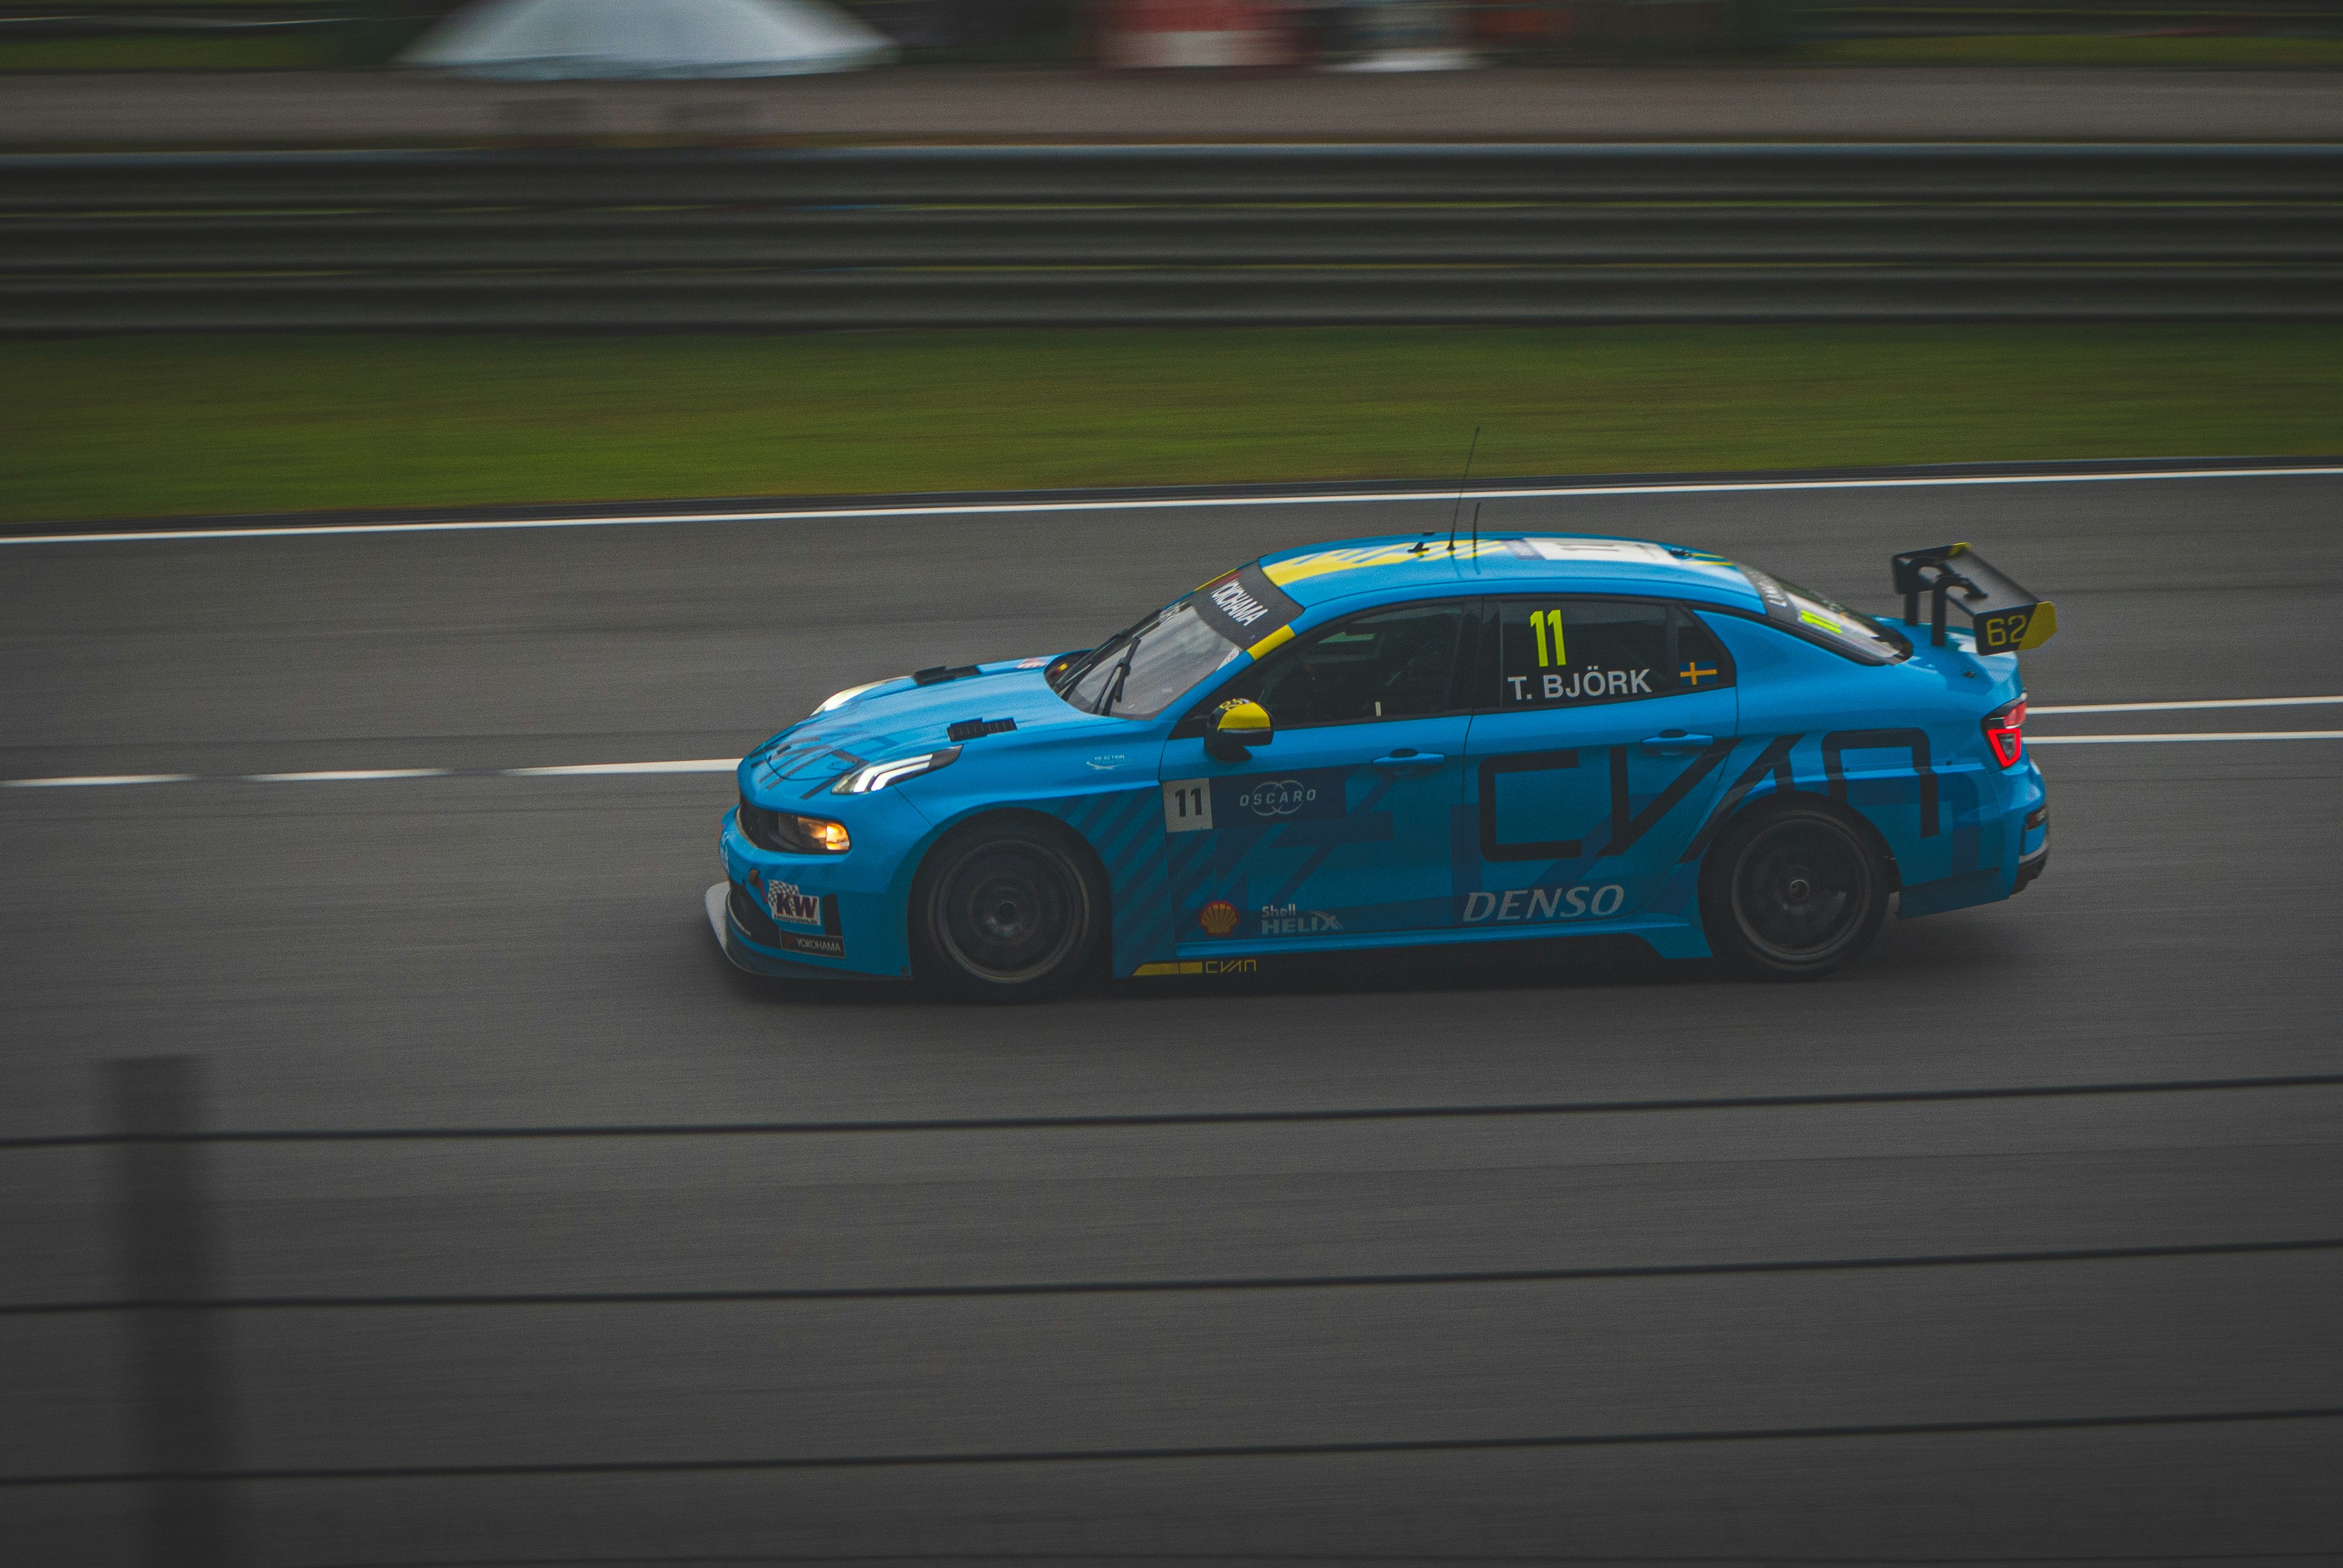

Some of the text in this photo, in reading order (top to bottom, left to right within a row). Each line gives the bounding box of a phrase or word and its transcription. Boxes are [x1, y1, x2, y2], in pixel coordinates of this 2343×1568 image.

[1529, 609, 1567, 667] 11
[1986, 614, 2027, 647] 62
[1507, 665, 1653, 701] T. BJÖRK
[1175, 787, 1203, 818] 11
[1239, 789, 1317, 807] OSCARO
[776, 892, 819, 920] KW
[1262, 903, 1296, 917] Shell
[1462, 884, 1625, 923] DENSO
[1262, 910, 1343, 935] HELIX
[796, 938, 842, 952] YOKOHAMA
